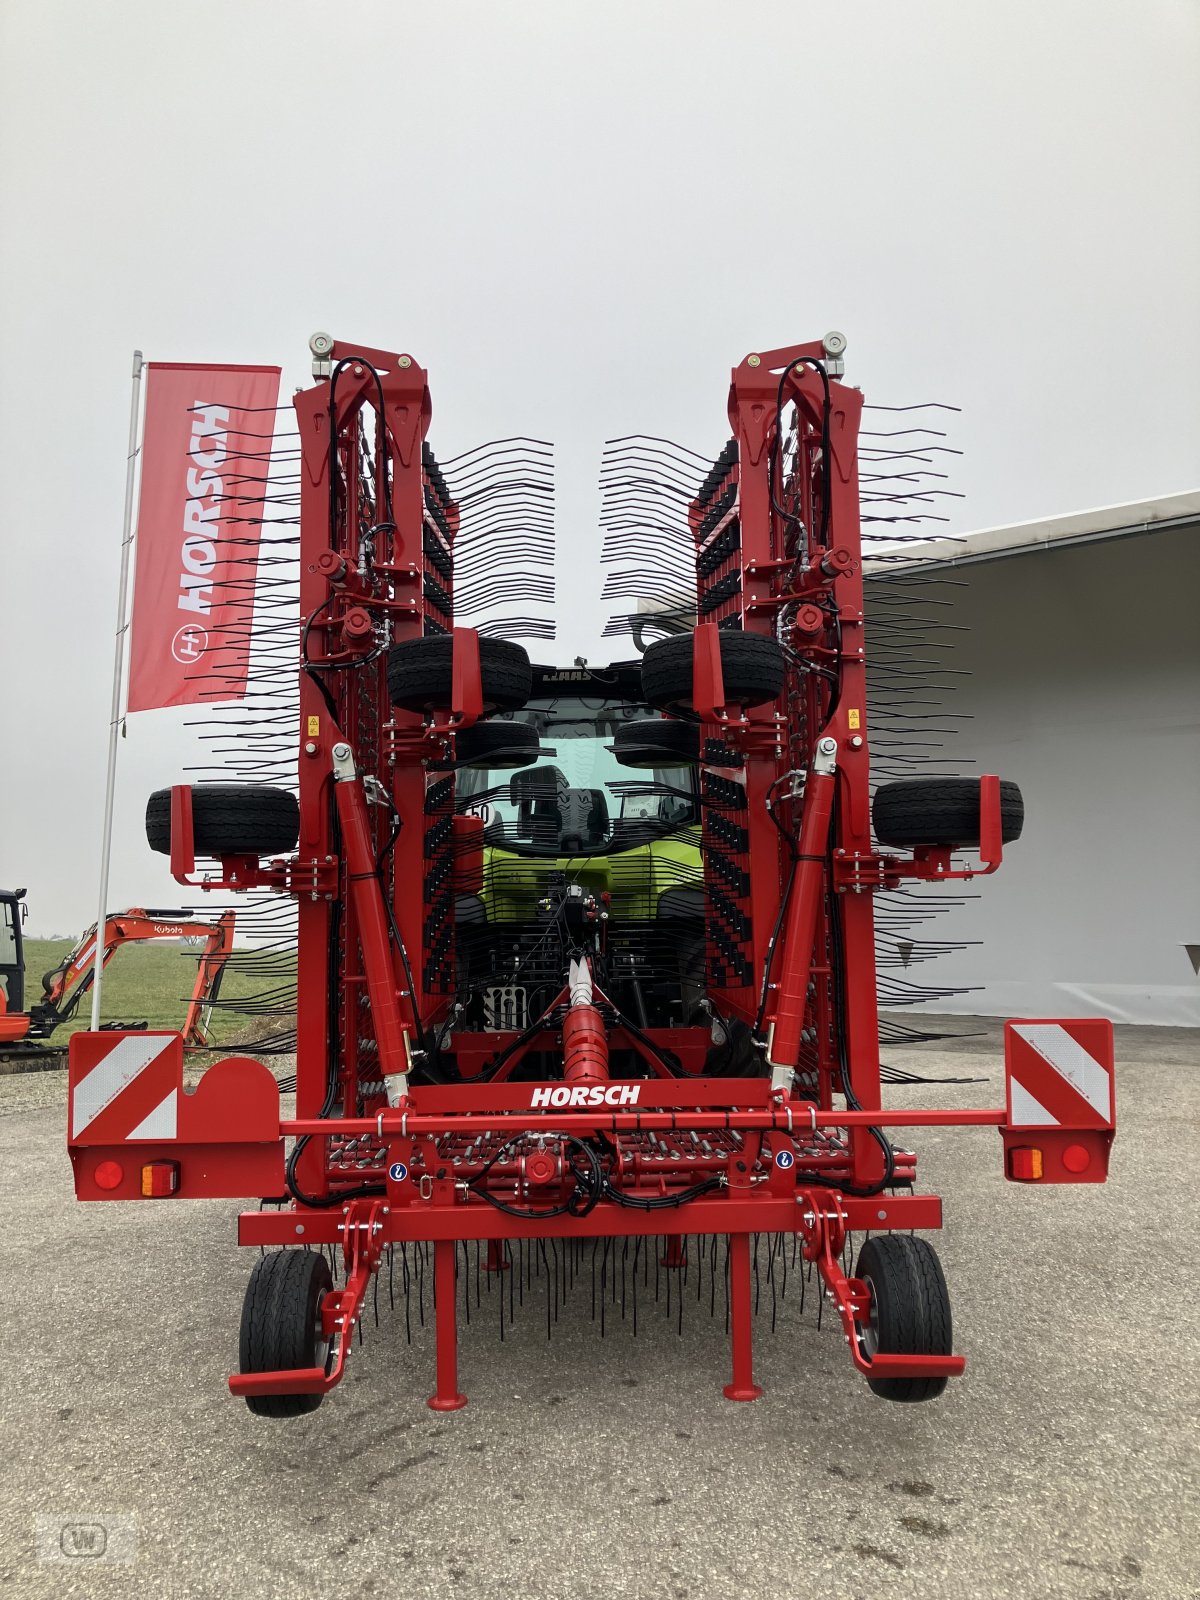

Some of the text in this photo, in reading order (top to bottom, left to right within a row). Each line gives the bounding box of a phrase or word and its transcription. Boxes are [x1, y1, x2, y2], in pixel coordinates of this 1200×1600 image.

[177, 400, 230, 615] HORSCH
[154, 925, 183, 934] Kubota
[530, 1085, 641, 1107] HORSCH
